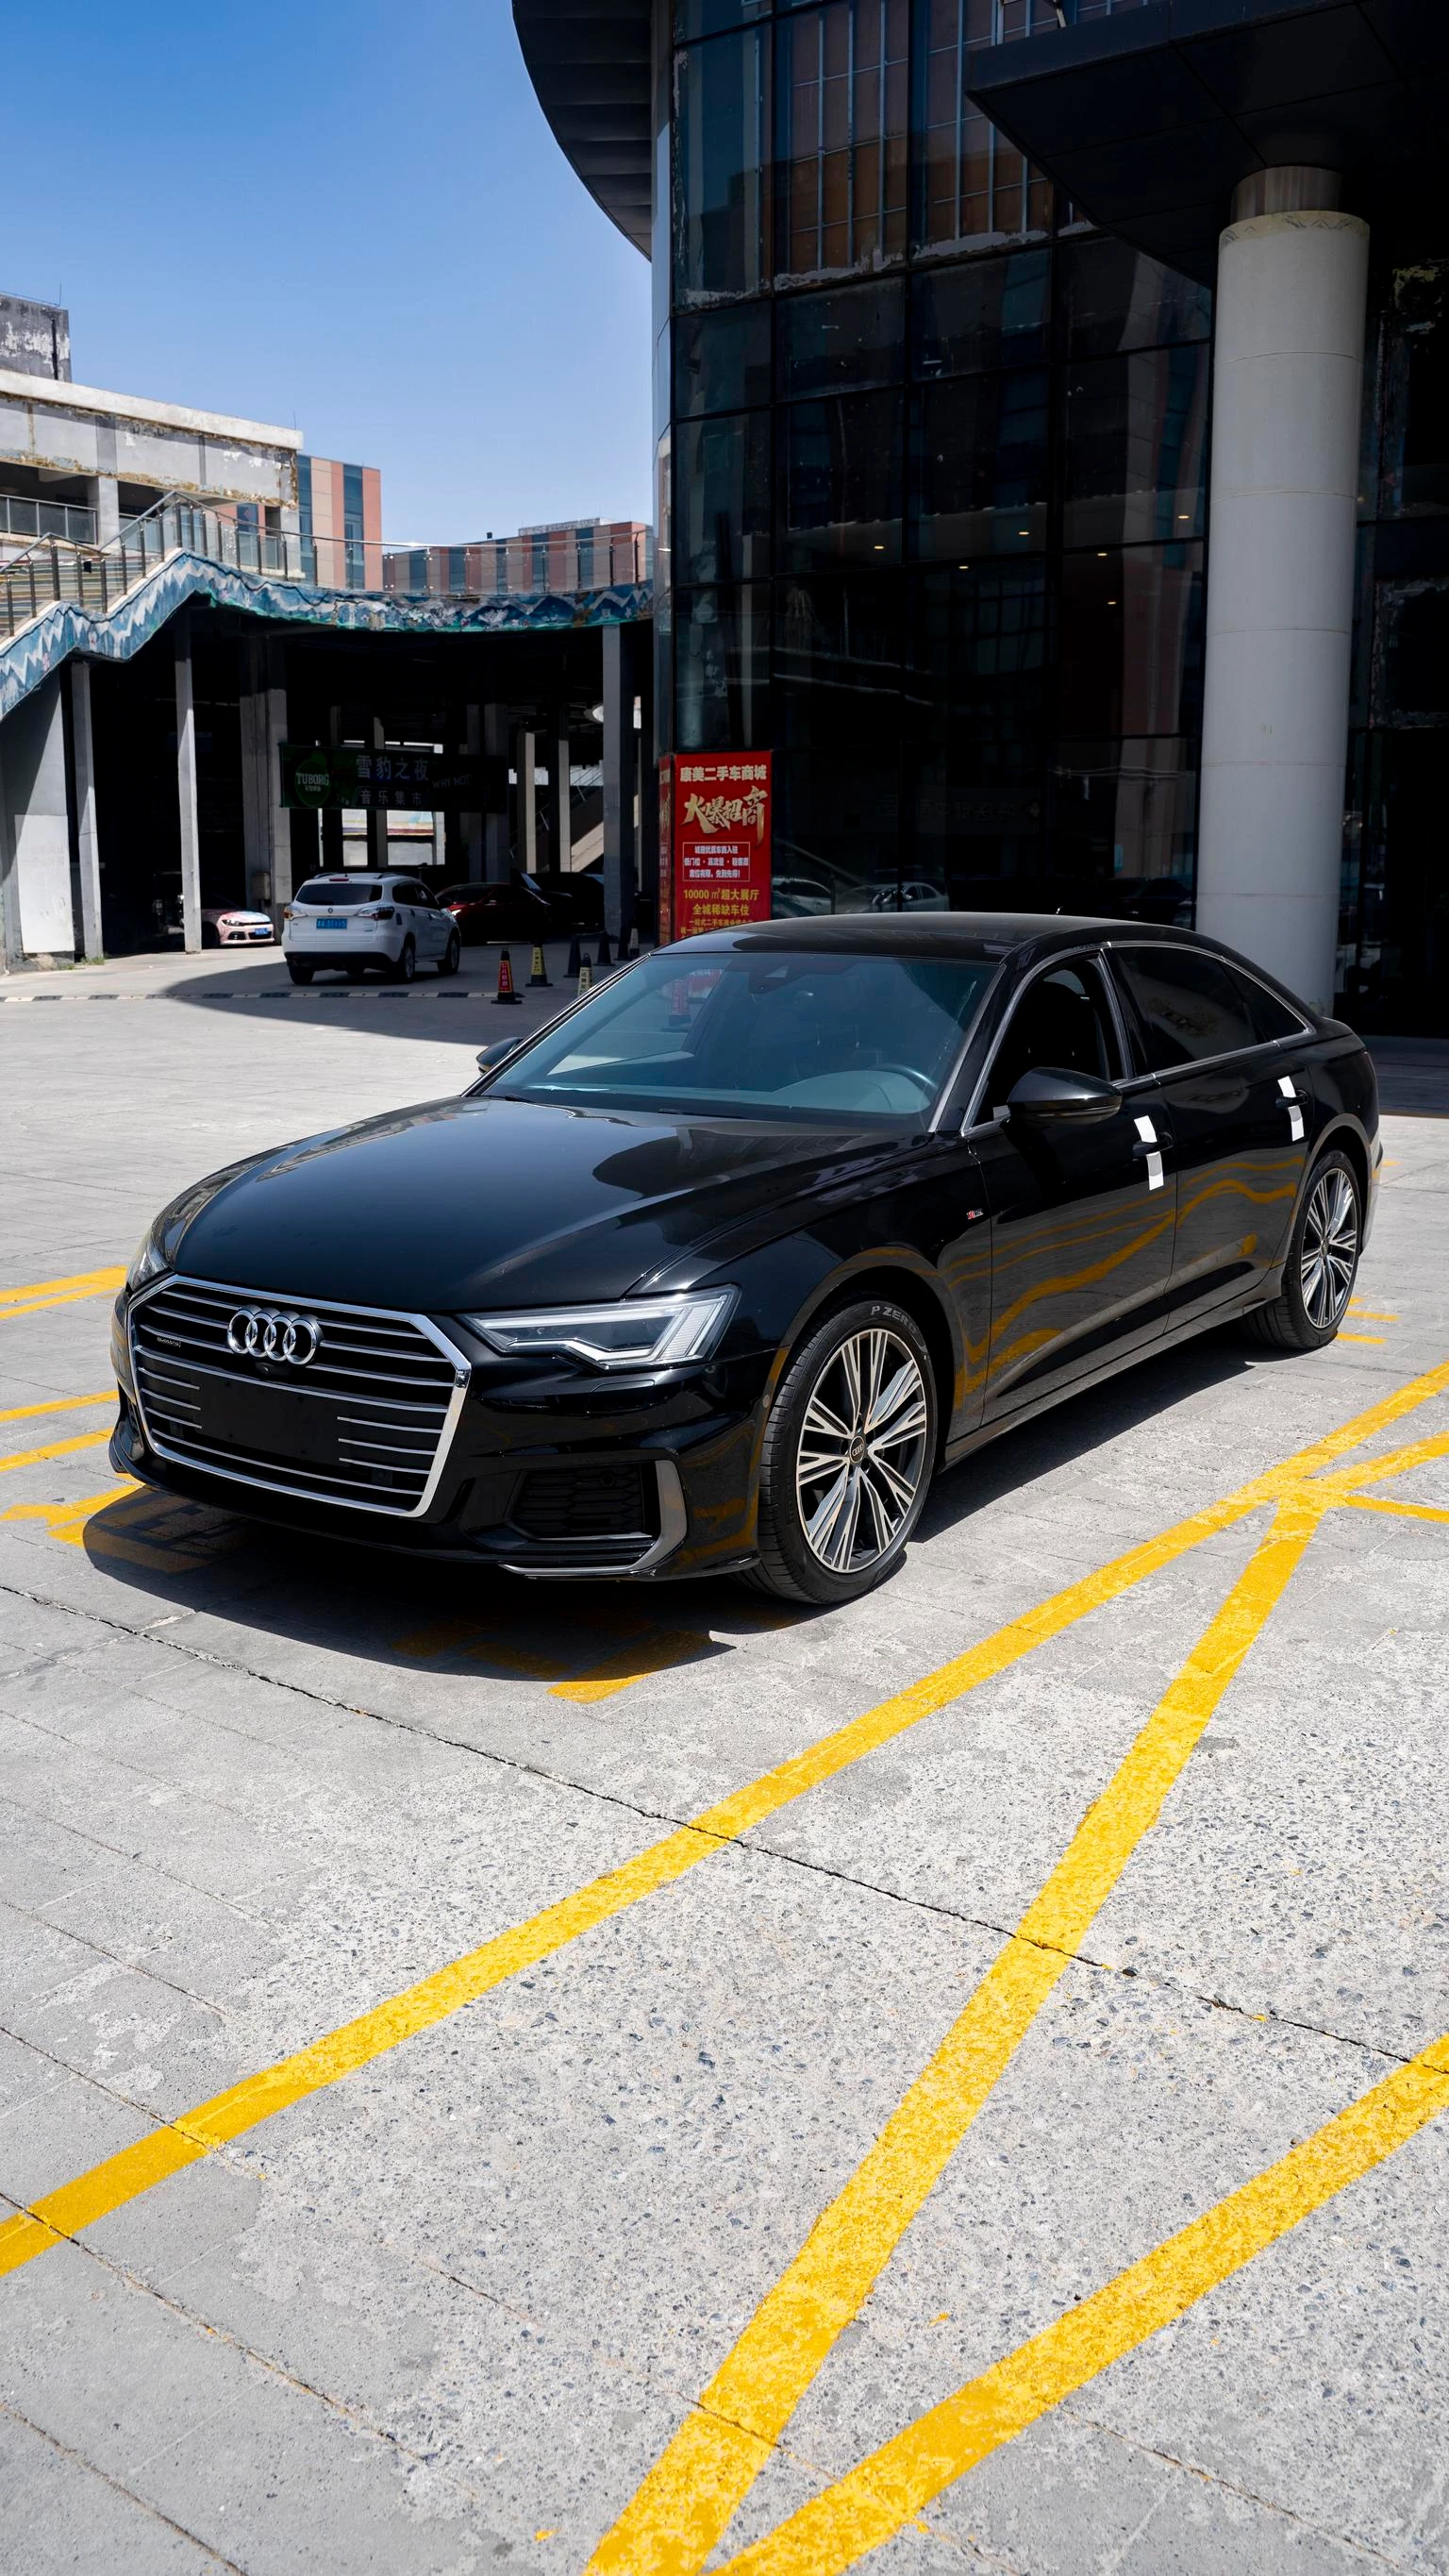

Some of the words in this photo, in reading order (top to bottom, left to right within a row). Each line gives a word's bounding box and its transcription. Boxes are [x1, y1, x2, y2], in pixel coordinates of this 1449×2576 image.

[356, 754, 429, 782] 雪豹之夜
[679, 764, 768, 782] 康美二手车商城
[295, 772, 330, 786] TUBORG
[360, 790, 425, 807] 音乐集市
[680, 785, 769, 845] 火爆招商
[871, 1305, 880, 1316] P
